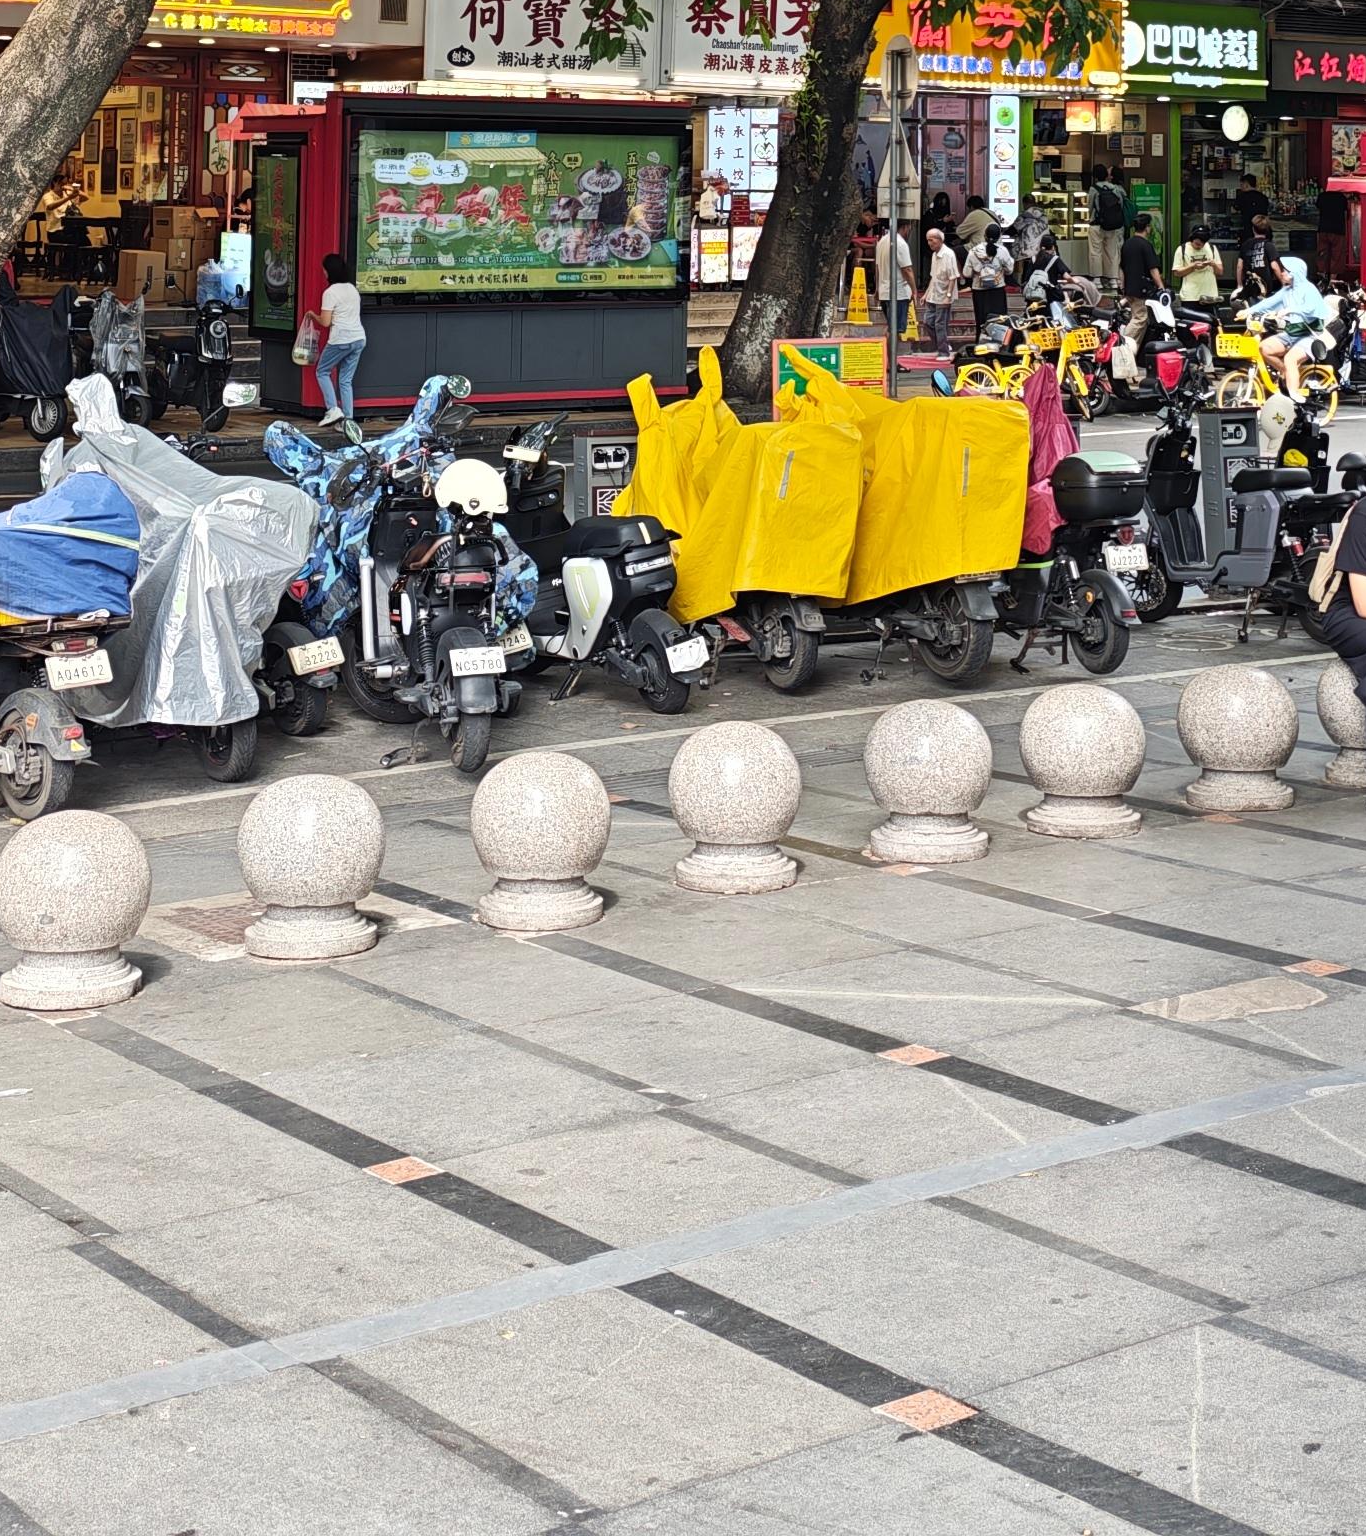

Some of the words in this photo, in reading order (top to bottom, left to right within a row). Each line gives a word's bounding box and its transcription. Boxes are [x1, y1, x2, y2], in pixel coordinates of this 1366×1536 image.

[711, 38, 740, 50] Chaoshan
[1146, 23, 1247, 69] 巴巴娘惹
[497, 51, 593, 71] 潮汕老式甜汤
[703, 52, 806, 76] 潮汕薄皮蒸饺
[455, 658, 503, 672] NC5780
